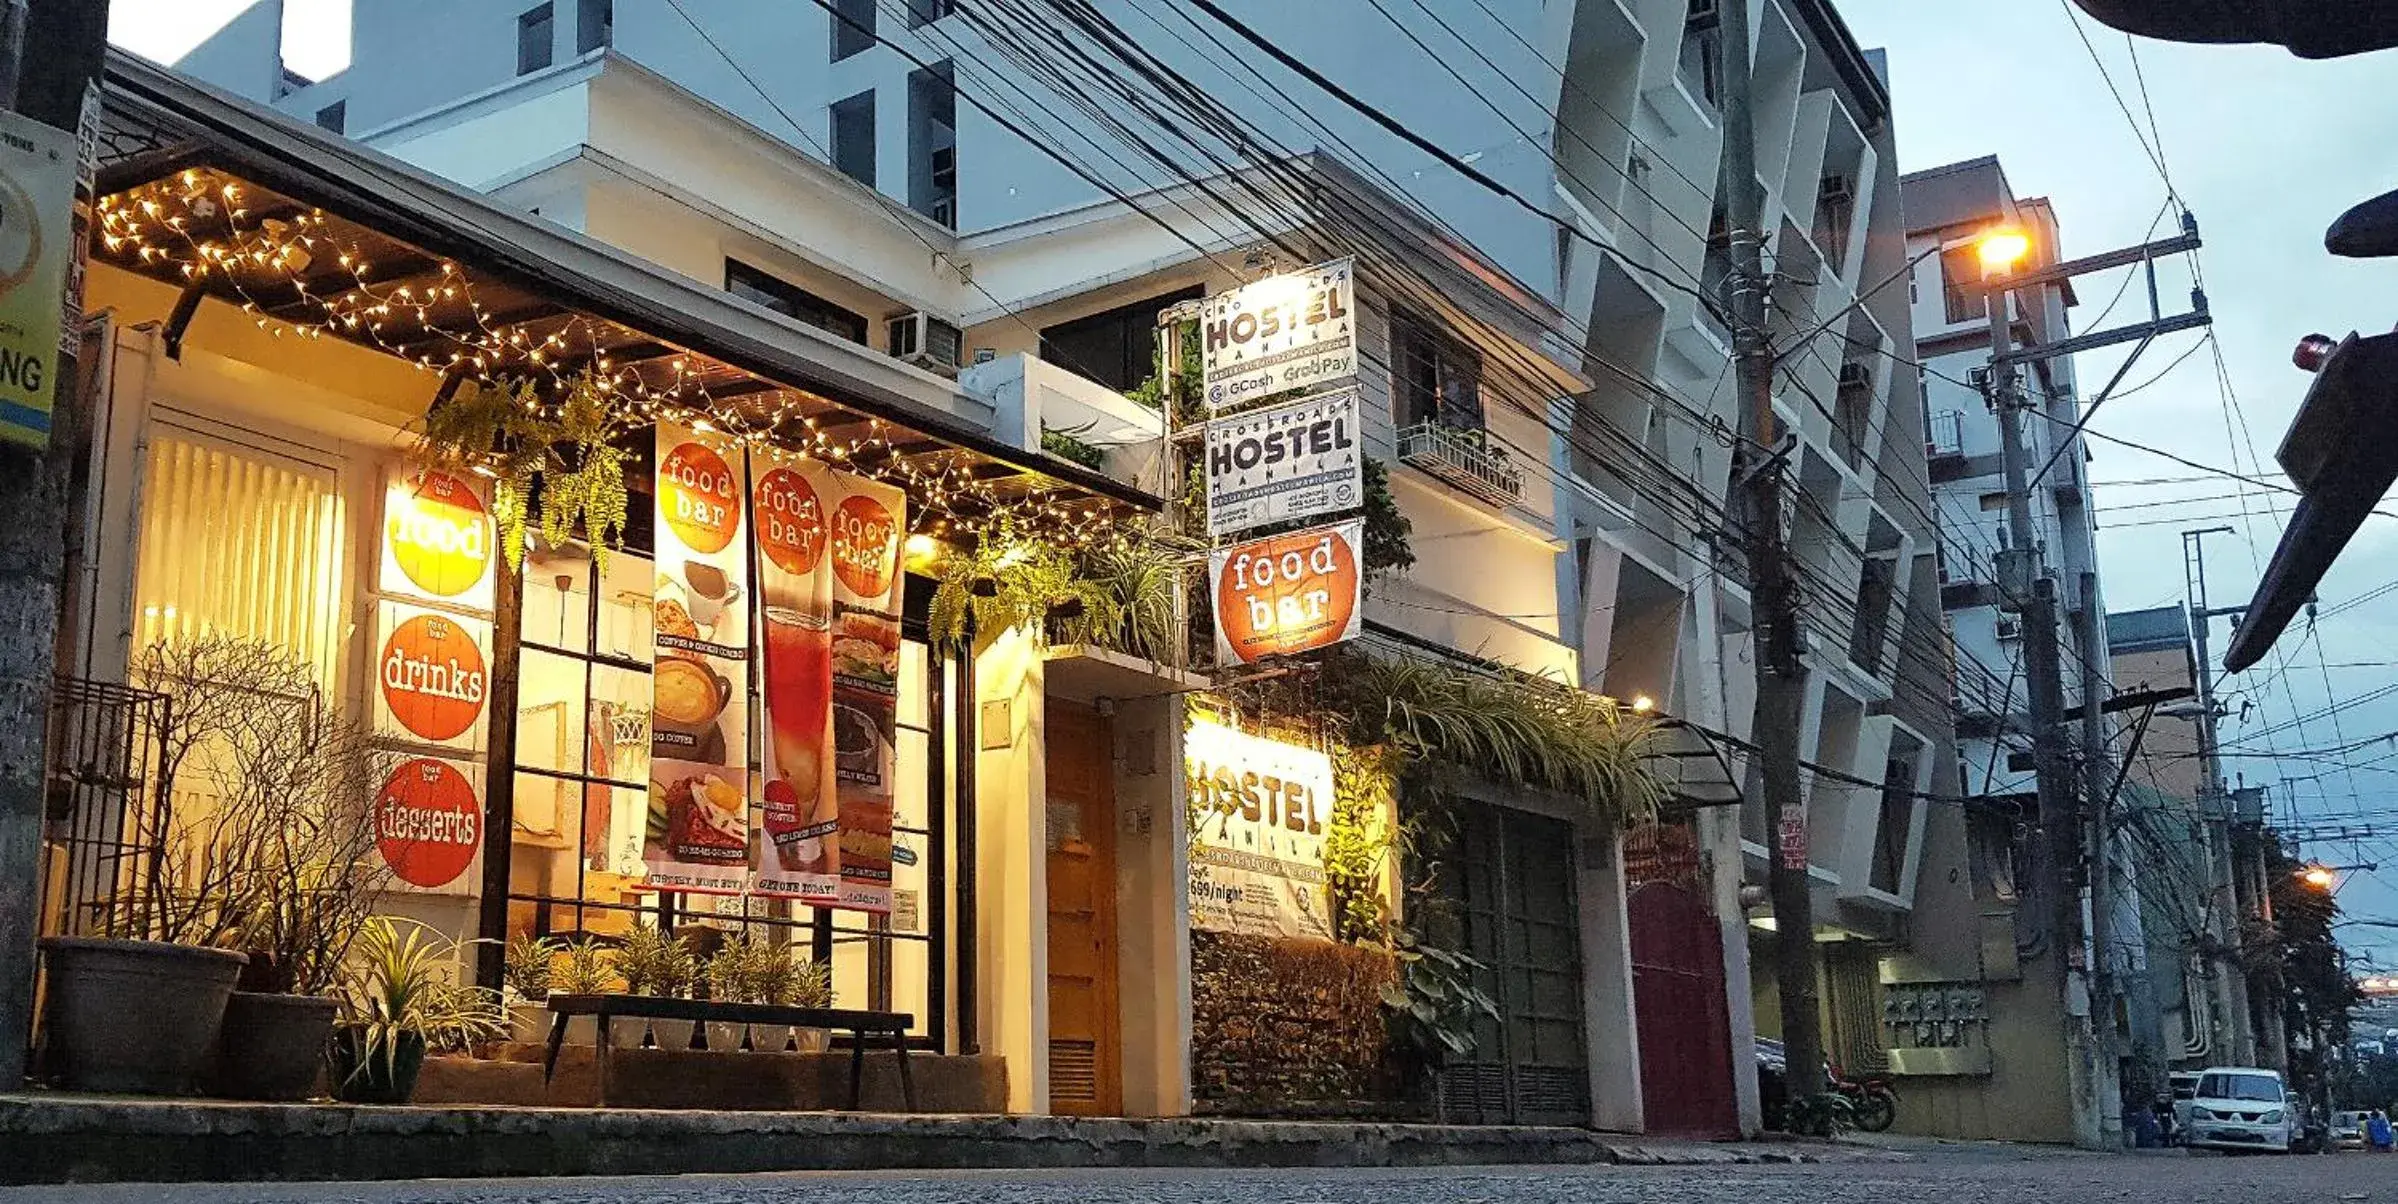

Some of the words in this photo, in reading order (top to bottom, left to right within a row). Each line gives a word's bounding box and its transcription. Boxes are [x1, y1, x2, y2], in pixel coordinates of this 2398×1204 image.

[1205, 270, 1346, 318] CROADS
[1208, 323, 1348, 368] MANILA
[1230, 374, 1274, 395] GCash
[1284, 356, 1350, 382] GrabPay
[1210, 401, 1352, 442] CROSSROADS
[1211, 417, 1352, 477] HOSTEL
[669, 457, 732, 499] food
[1213, 454, 1353, 493] MANILA
[675, 488, 726, 527] bar
[761, 482, 818, 521] food
[394, 507, 485, 560] food
[768, 514, 814, 548] bar
[838, 508, 894, 544] food
[1234, 537, 1337, 590] food
[1245, 589, 1330, 631] bar
[385, 648, 481, 702] drinks
[382, 796, 475, 846] desserts
